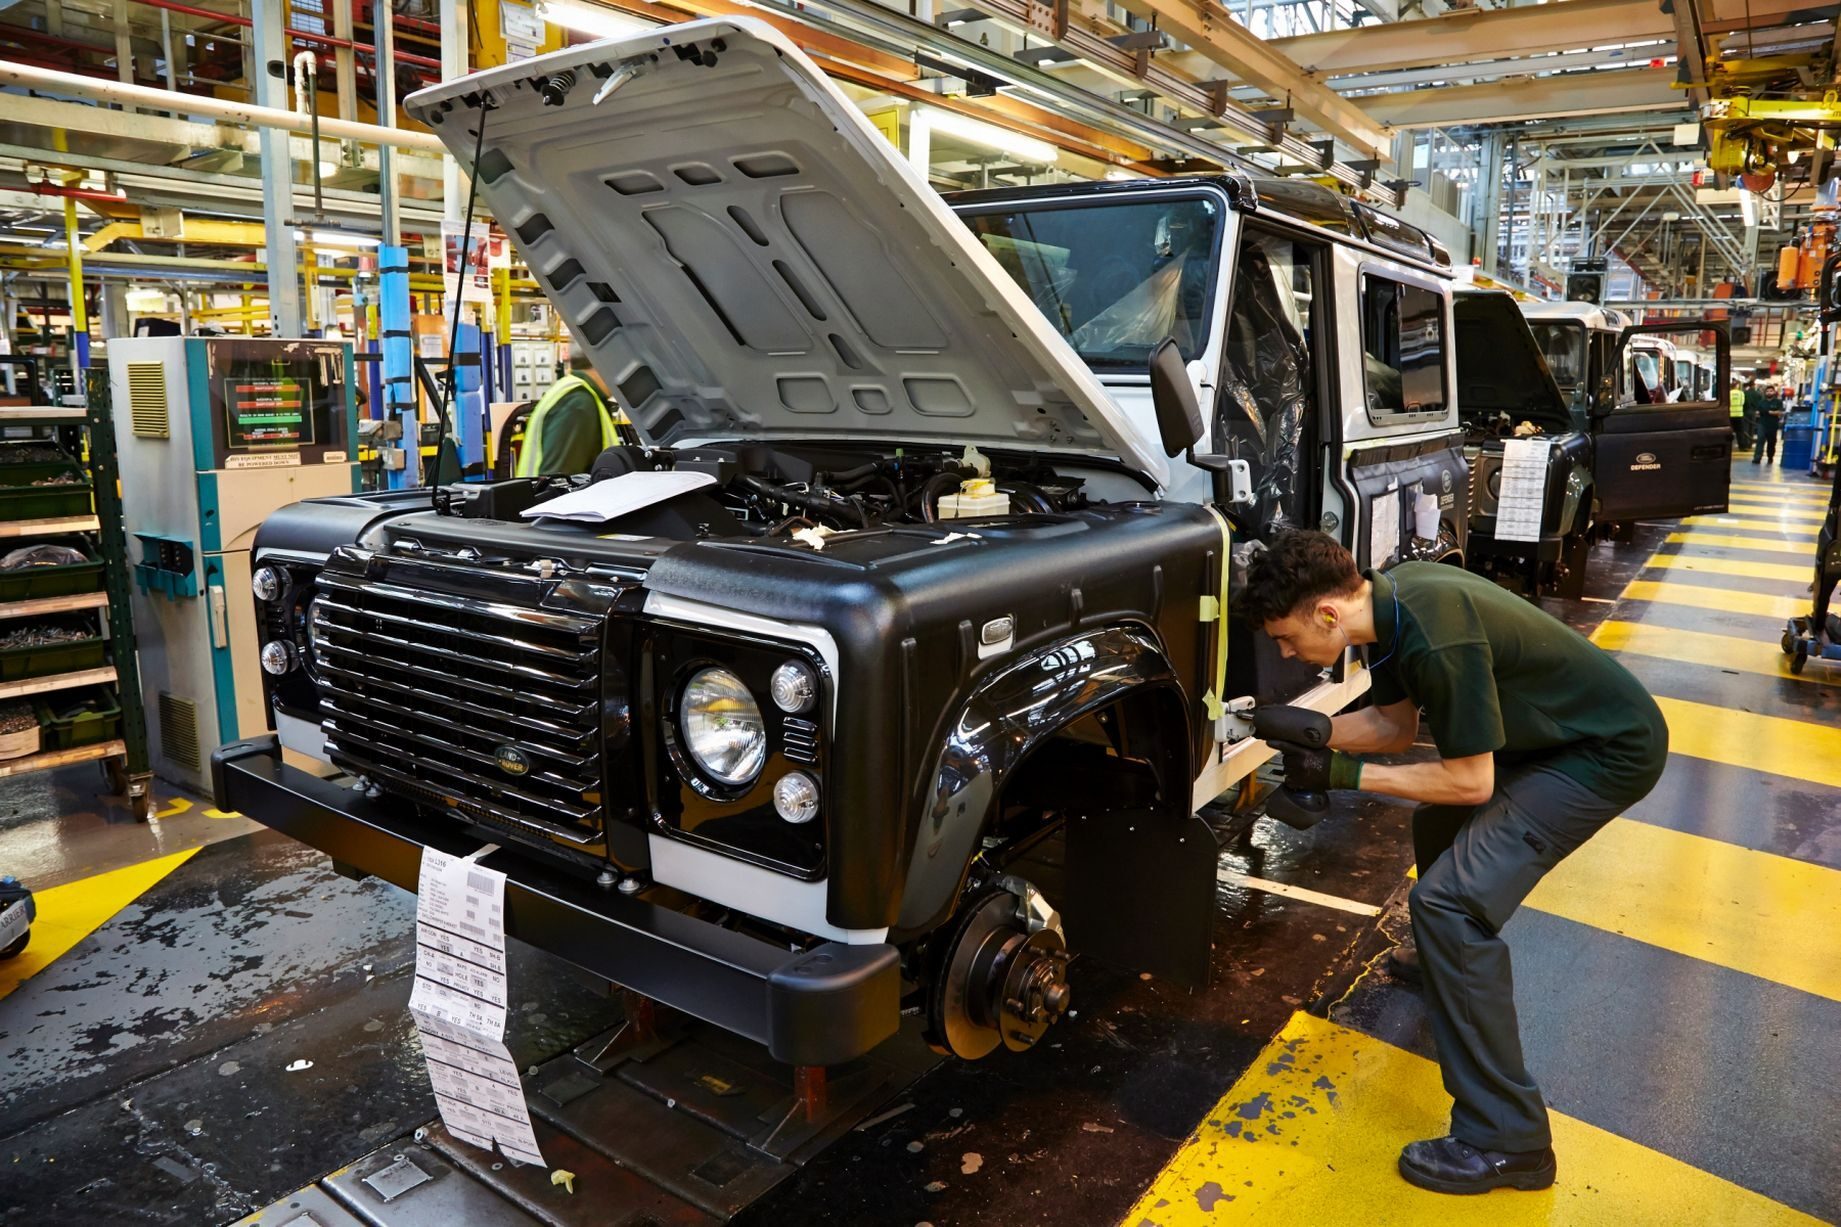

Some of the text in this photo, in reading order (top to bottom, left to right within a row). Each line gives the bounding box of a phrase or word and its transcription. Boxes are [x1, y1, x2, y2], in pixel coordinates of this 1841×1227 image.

[440, 933, 450, 942] YES
[473, 946, 484, 954] YES
[440, 944, 450, 953] YES
[474, 979, 484, 988] YES
[492, 975, 500, 983] NO
[440, 976, 450, 985] YES
[473, 989, 484, 998] YES
[491, 996, 501, 1004] YES
[417, 1003, 427, 1011] YES
[451, 1016, 462, 1025] YES
[453, 1070, 463, 1078] YES
